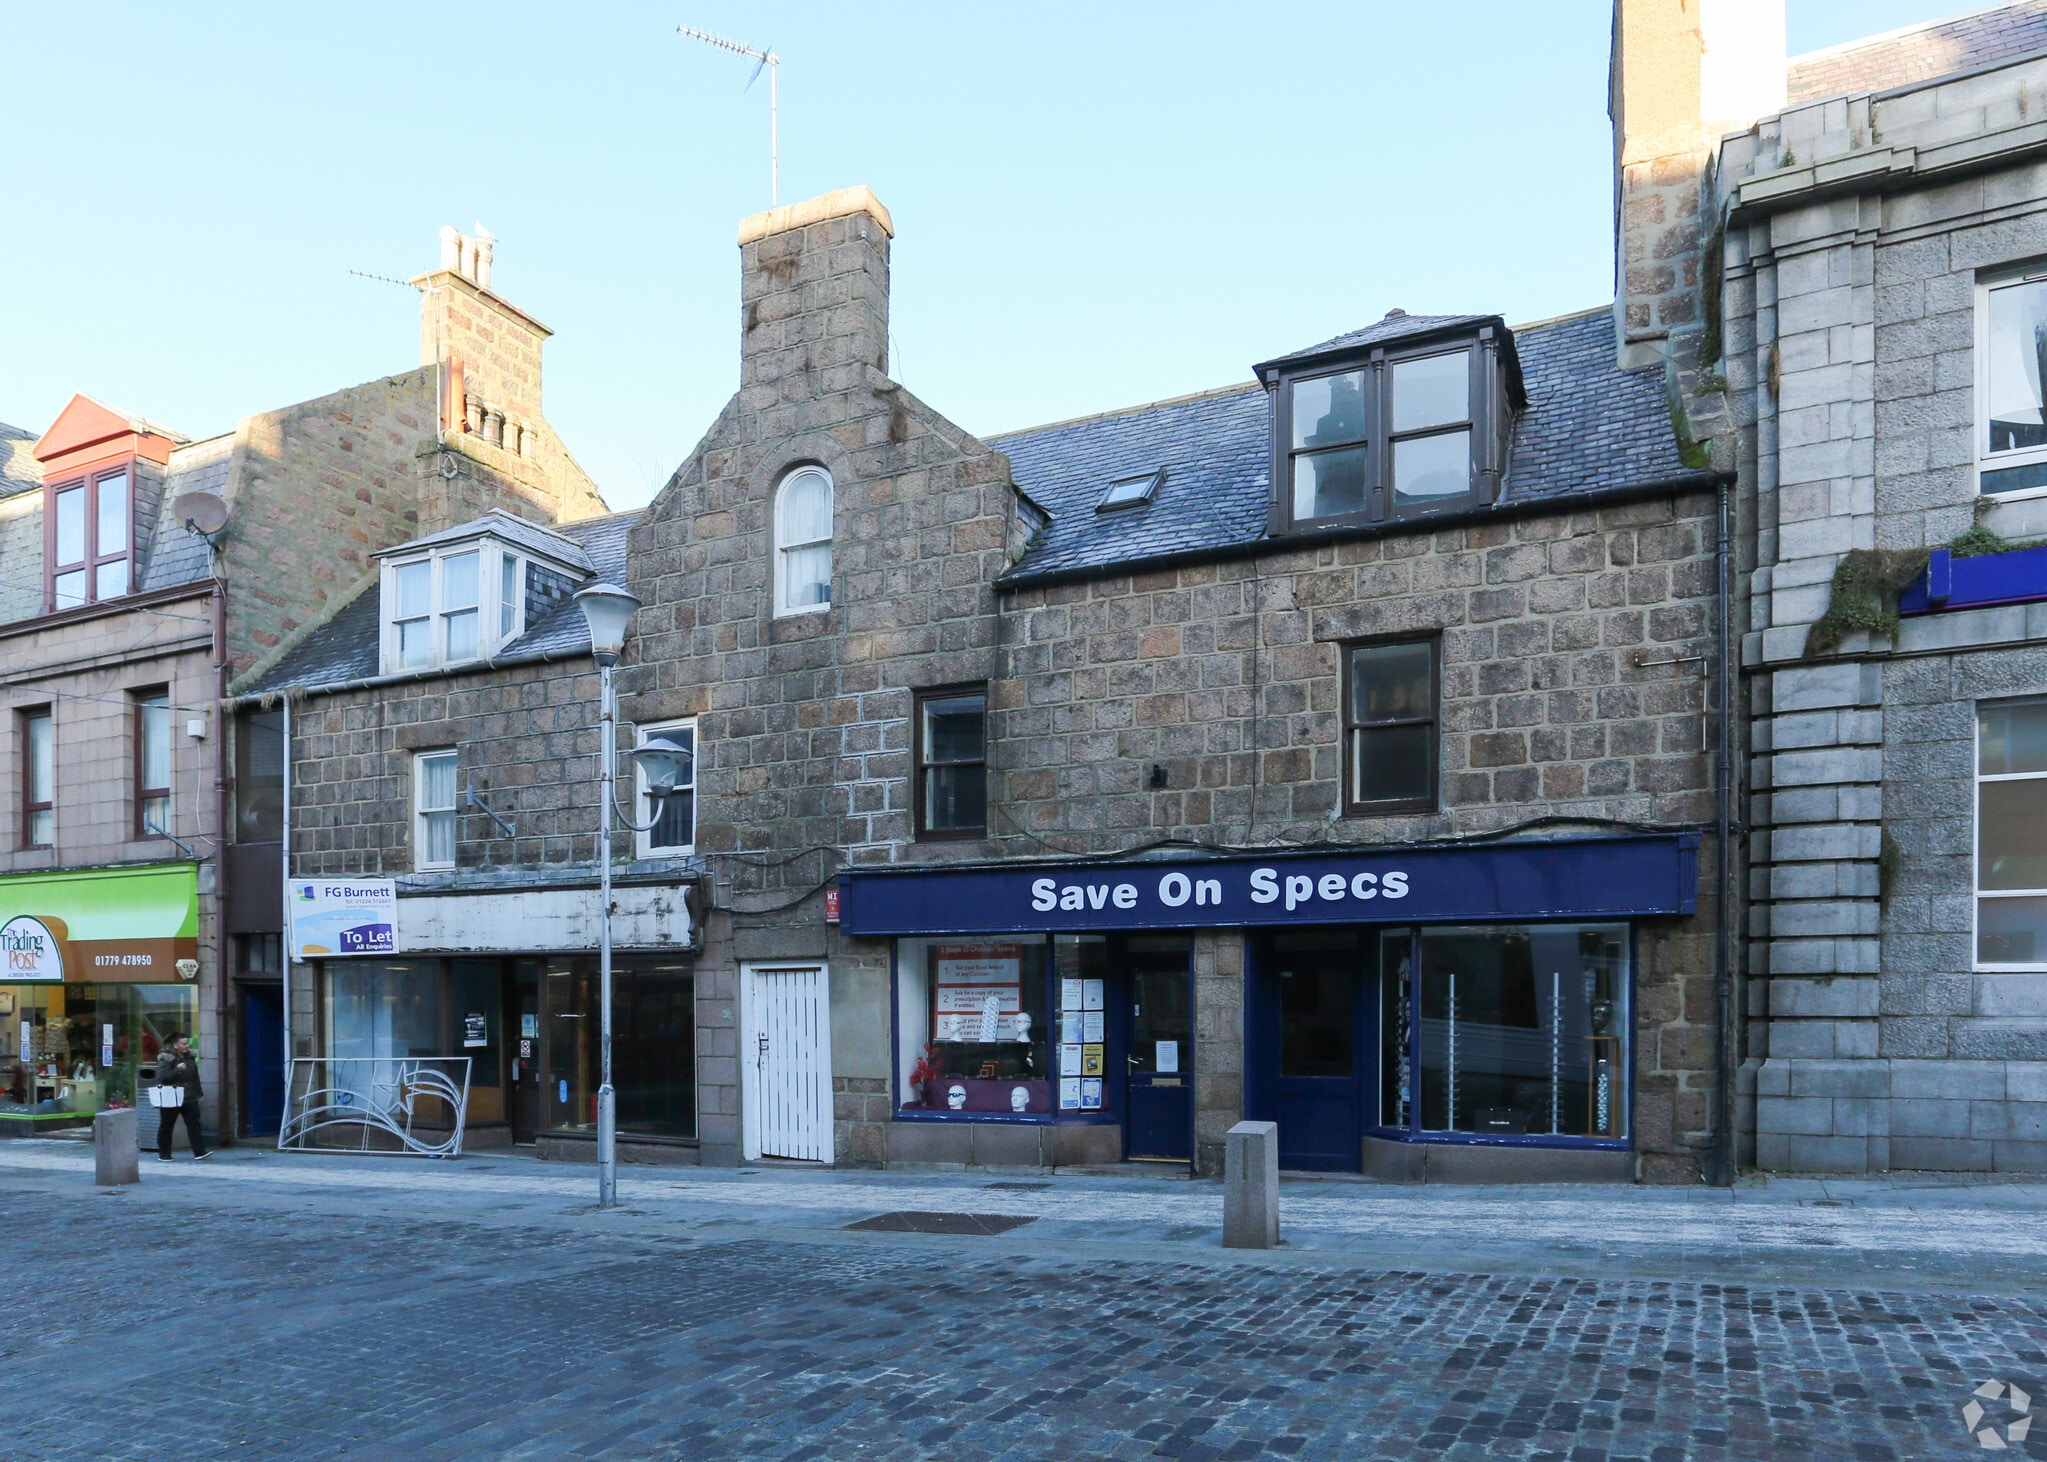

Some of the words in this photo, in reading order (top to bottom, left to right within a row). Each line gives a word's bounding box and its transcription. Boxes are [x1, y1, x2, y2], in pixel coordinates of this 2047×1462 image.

[325, 887, 341, 897] FG
[344, 887, 390, 897] Burnett
[1031, 878, 1138, 912] Save
[1158, 872, 1222, 907] On
[1250, 868, 1409, 911] Specs
[343, 931, 363, 943] To
[368, 930, 392, 943] Let
[0, 929, 44, 958] Trading
[366, 943, 392, 951] Enquiries
[9, 949, 36, 970] Post
[95, 955, 119, 966] 01779
[122, 954, 152, 966] 478950
[943, 994, 949, 1003] 2
[943, 1021, 949, 1030] 3
